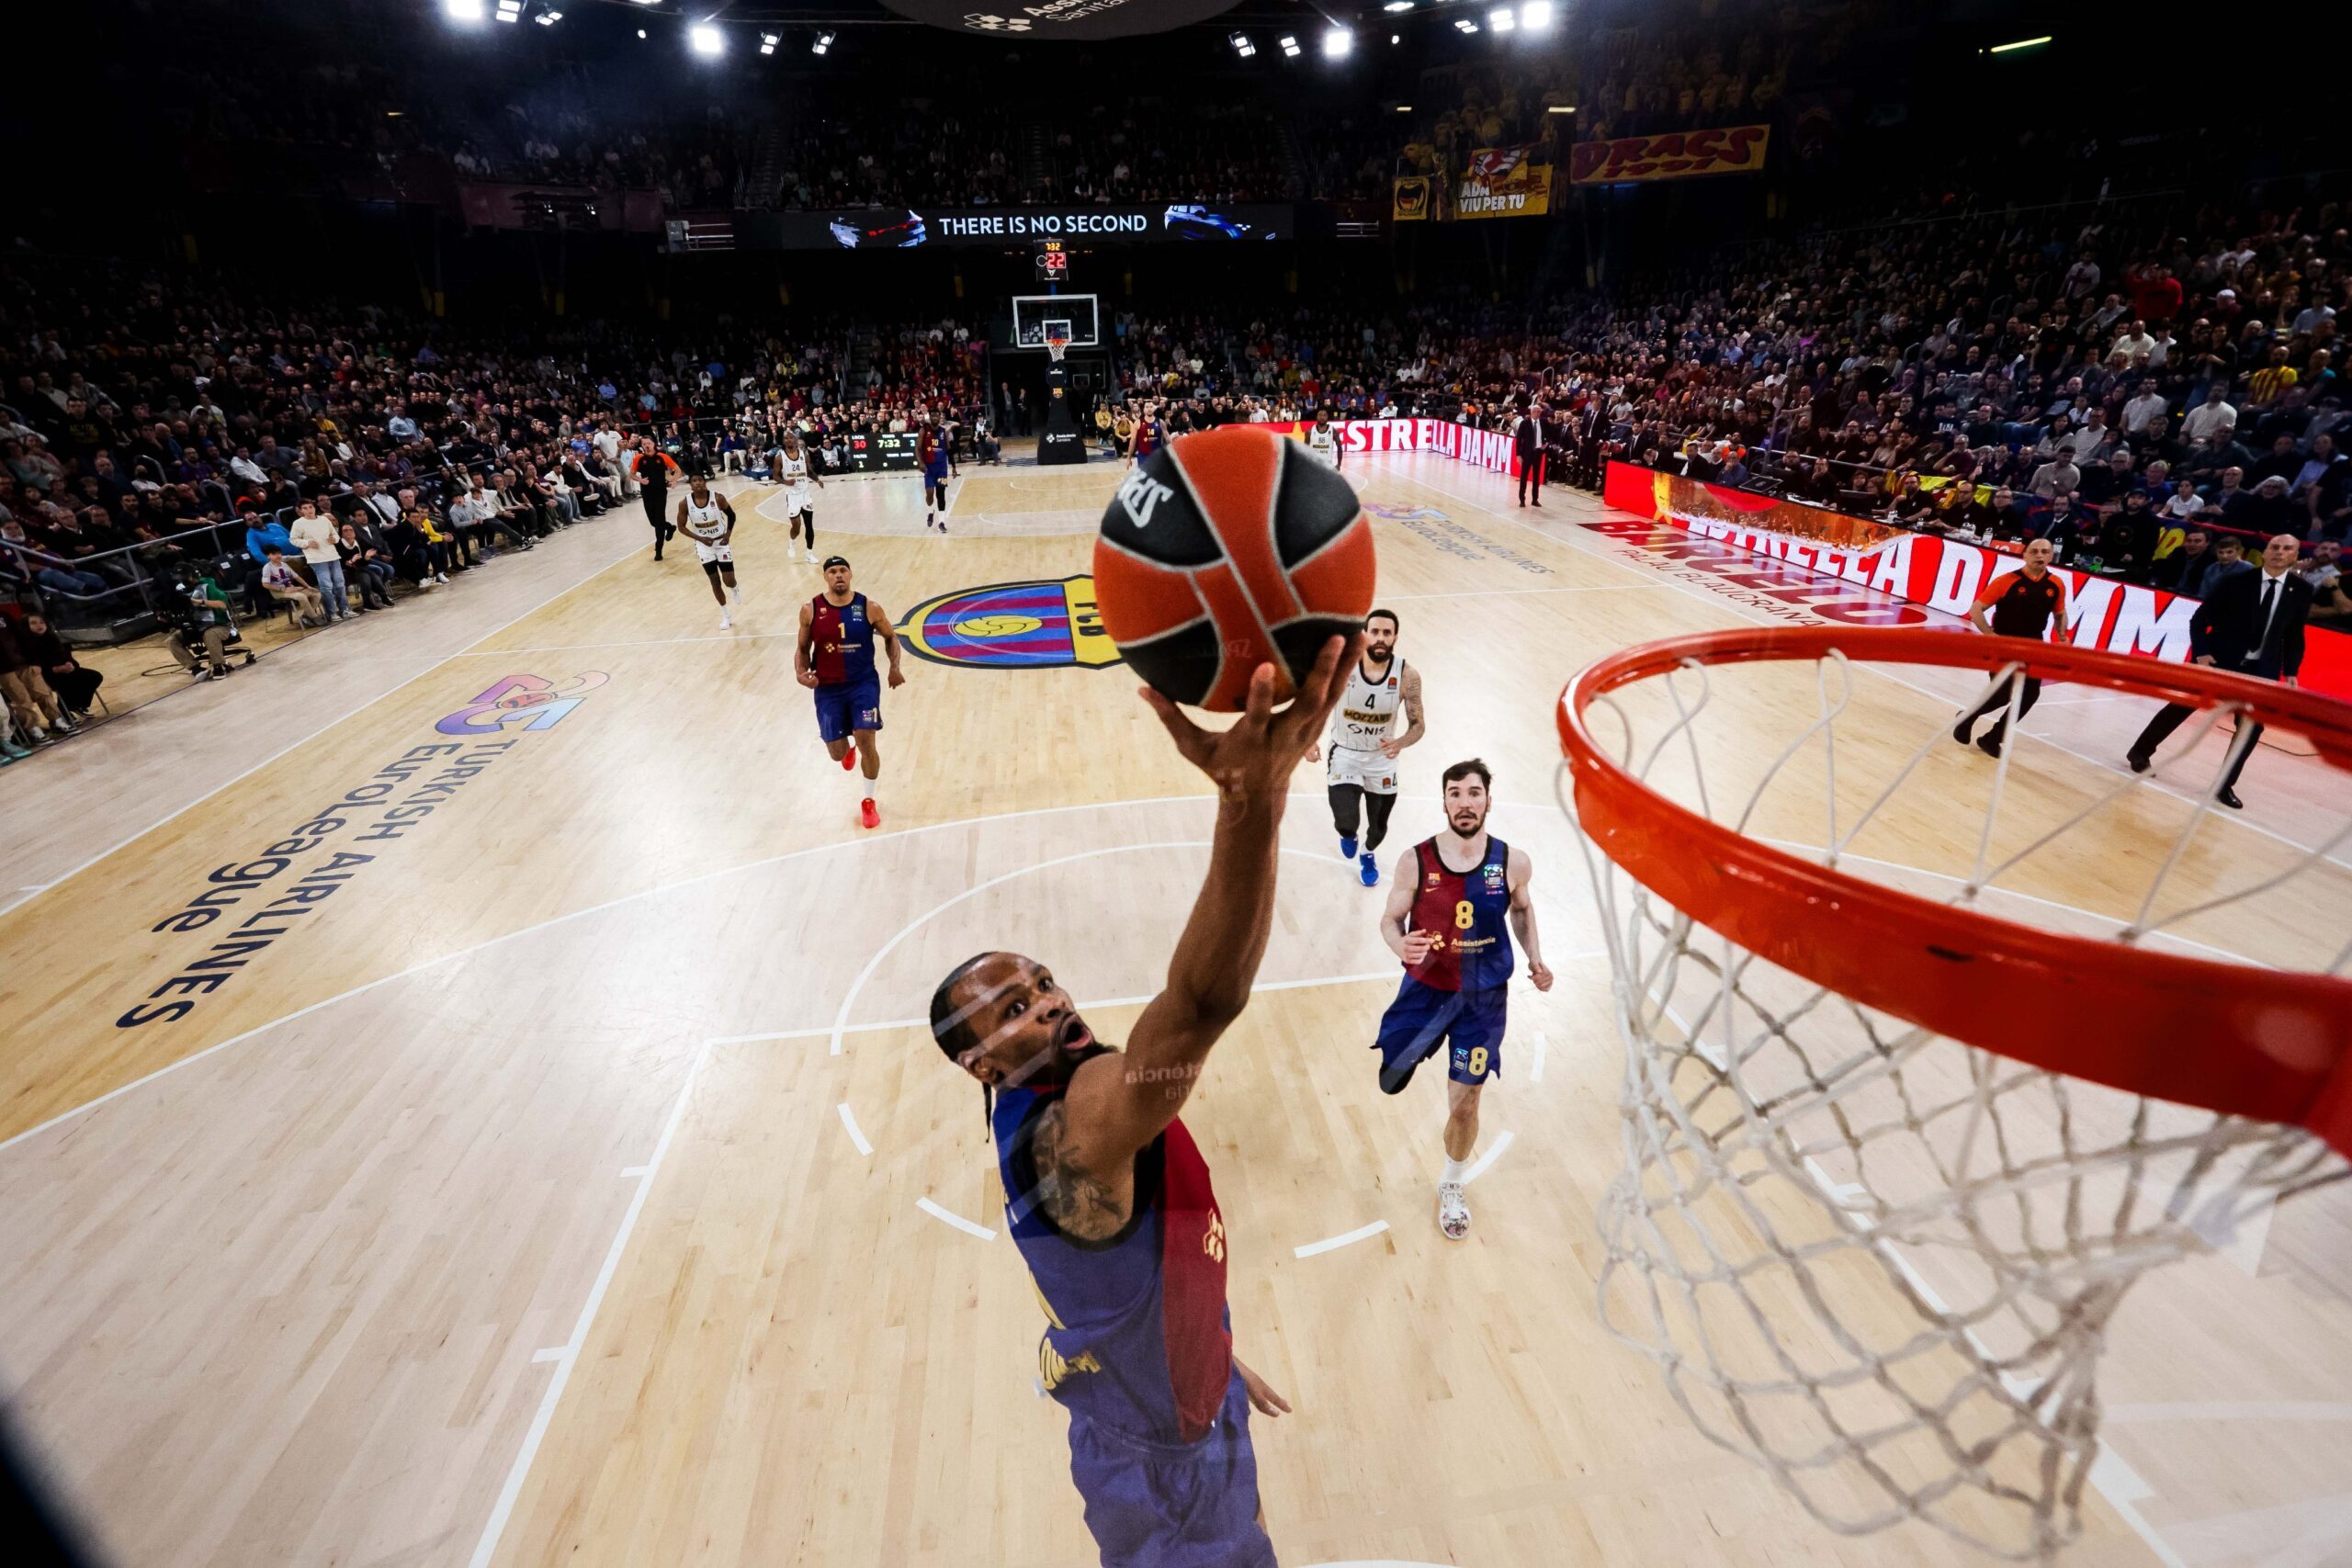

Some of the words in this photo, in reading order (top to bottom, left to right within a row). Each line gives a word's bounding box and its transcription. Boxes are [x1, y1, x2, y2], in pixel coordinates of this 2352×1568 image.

[1572, 128, 1765, 180] DRACS
[1460, 197, 1482, 213] VIU
[1482, 196, 1507, 211] PER
[1509, 194, 1525, 209] TU
[939, 217, 1004, 235] THERE
[1009, 217, 1026, 233] IS
[1031, 216, 1061, 233] NO
[1066, 215, 1148, 232] SECOND
[1046, 243, 1061, 251] 7:32
[1047, 254, 1065, 267] 22
[1147, 428, 1155, 436] 14
[854, 441, 867, 449] 30
[877, 439, 901, 448] 7:32
[931, 438, 939, 446] 10
[1459, 428, 1513, 475] DAMM
[791, 463, 800, 472] 24
[701, 512, 708, 522] 3
[1614, 549, 1675, 571] PALAU
[1674, 572, 1826, 626] BLAUGRANA
[838, 622, 846, 639] 1
[1364, 694, 1376, 710] 4
[873, 707, 877, 723] 1
[1364, 726, 1386, 736] NIS
[354, 739, 519, 841] TURKISH
[152, 742, 464, 933] EuroLeague
[1455, 900, 1474, 930] 8
[116, 852, 377, 1029] AIRLINES
[1469, 1046, 1488, 1076] 8
